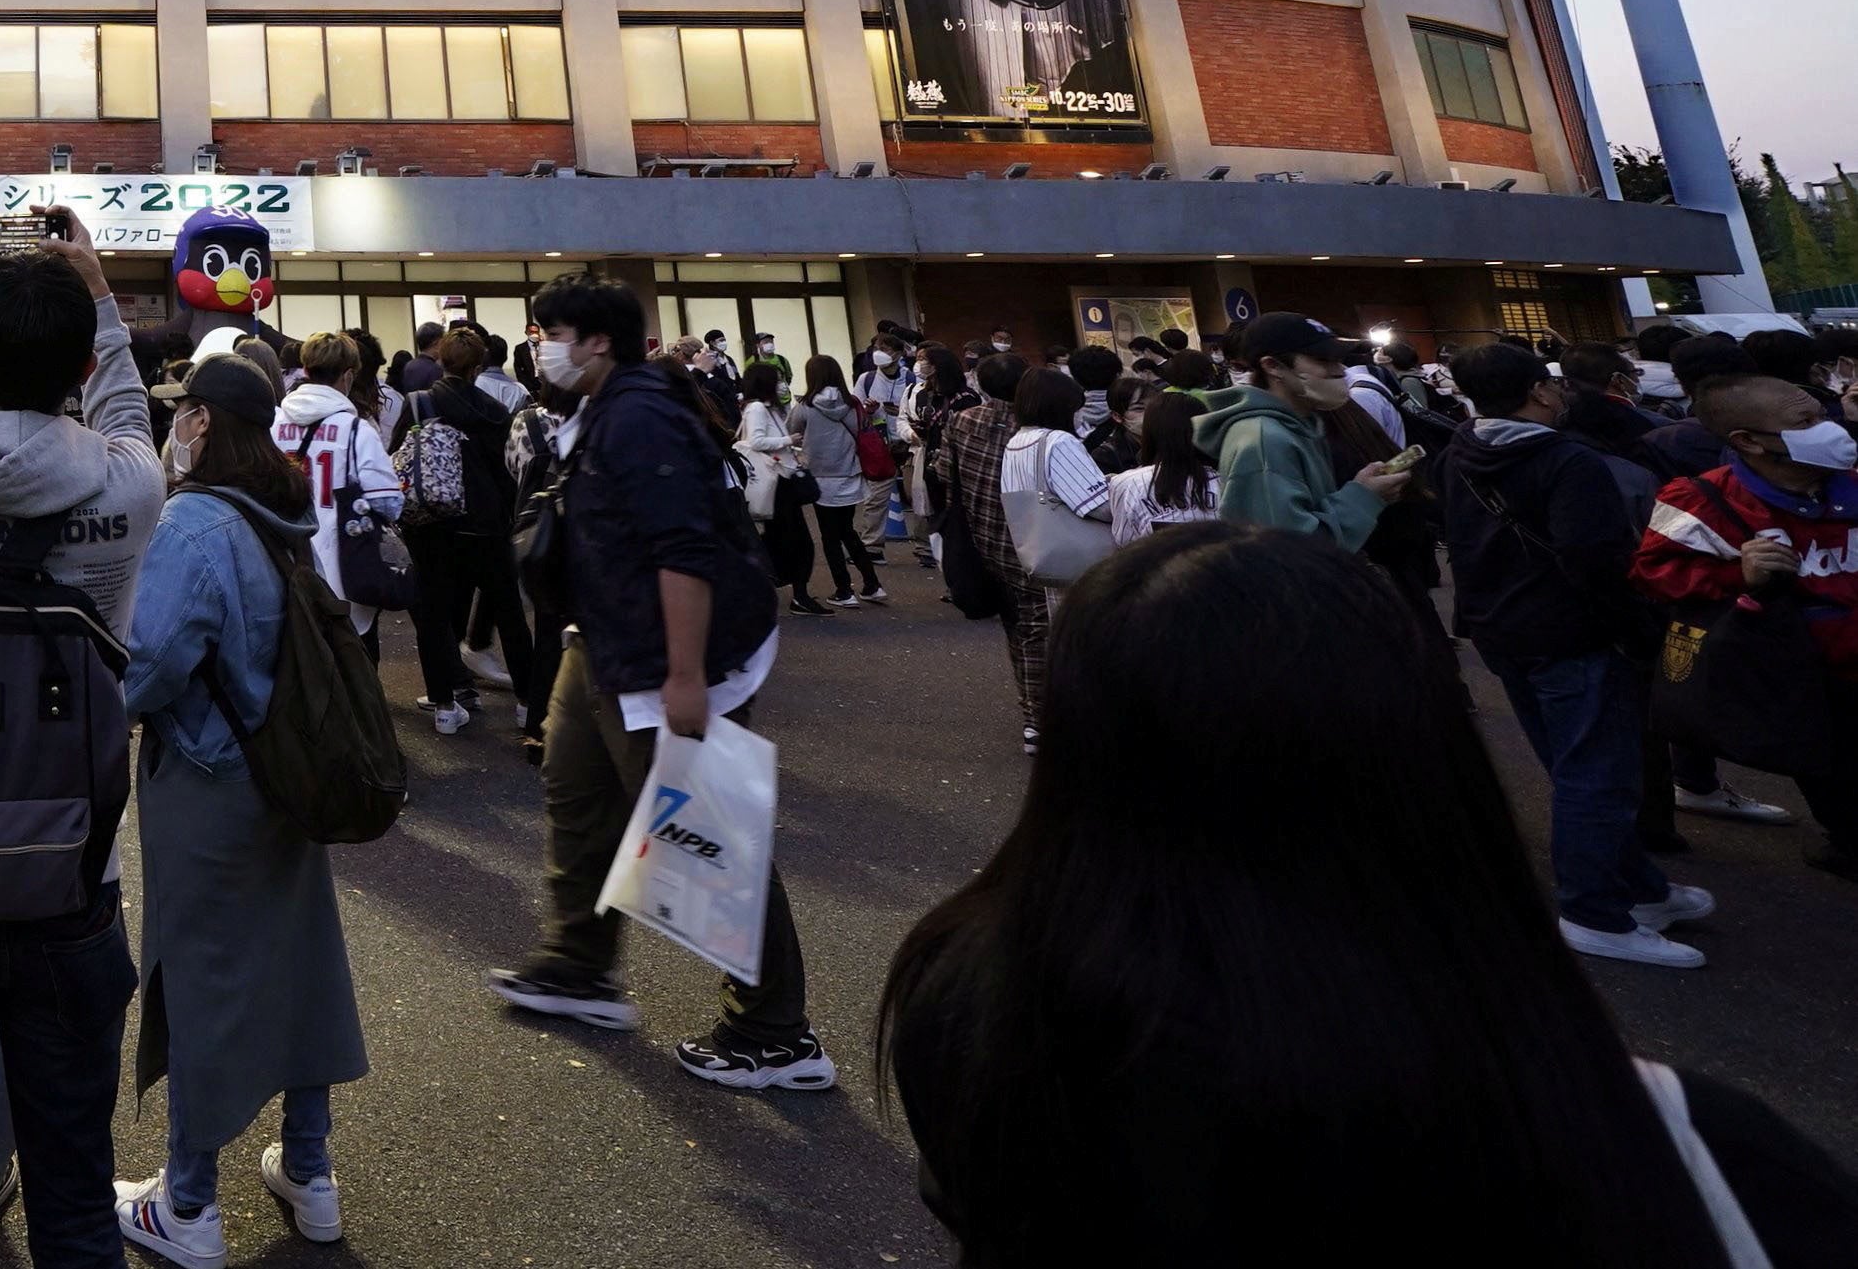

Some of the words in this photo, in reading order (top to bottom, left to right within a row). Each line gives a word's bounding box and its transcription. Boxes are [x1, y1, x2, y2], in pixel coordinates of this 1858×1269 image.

[140, 183, 291, 213] 2022
[95, 226, 178, 243] バファロー
[1236, 296, 1250, 320] 6
[278, 423, 339, 442] KOYNO
[76, 507, 99, 516] 2021
[658, 822, 723, 859] NPB
